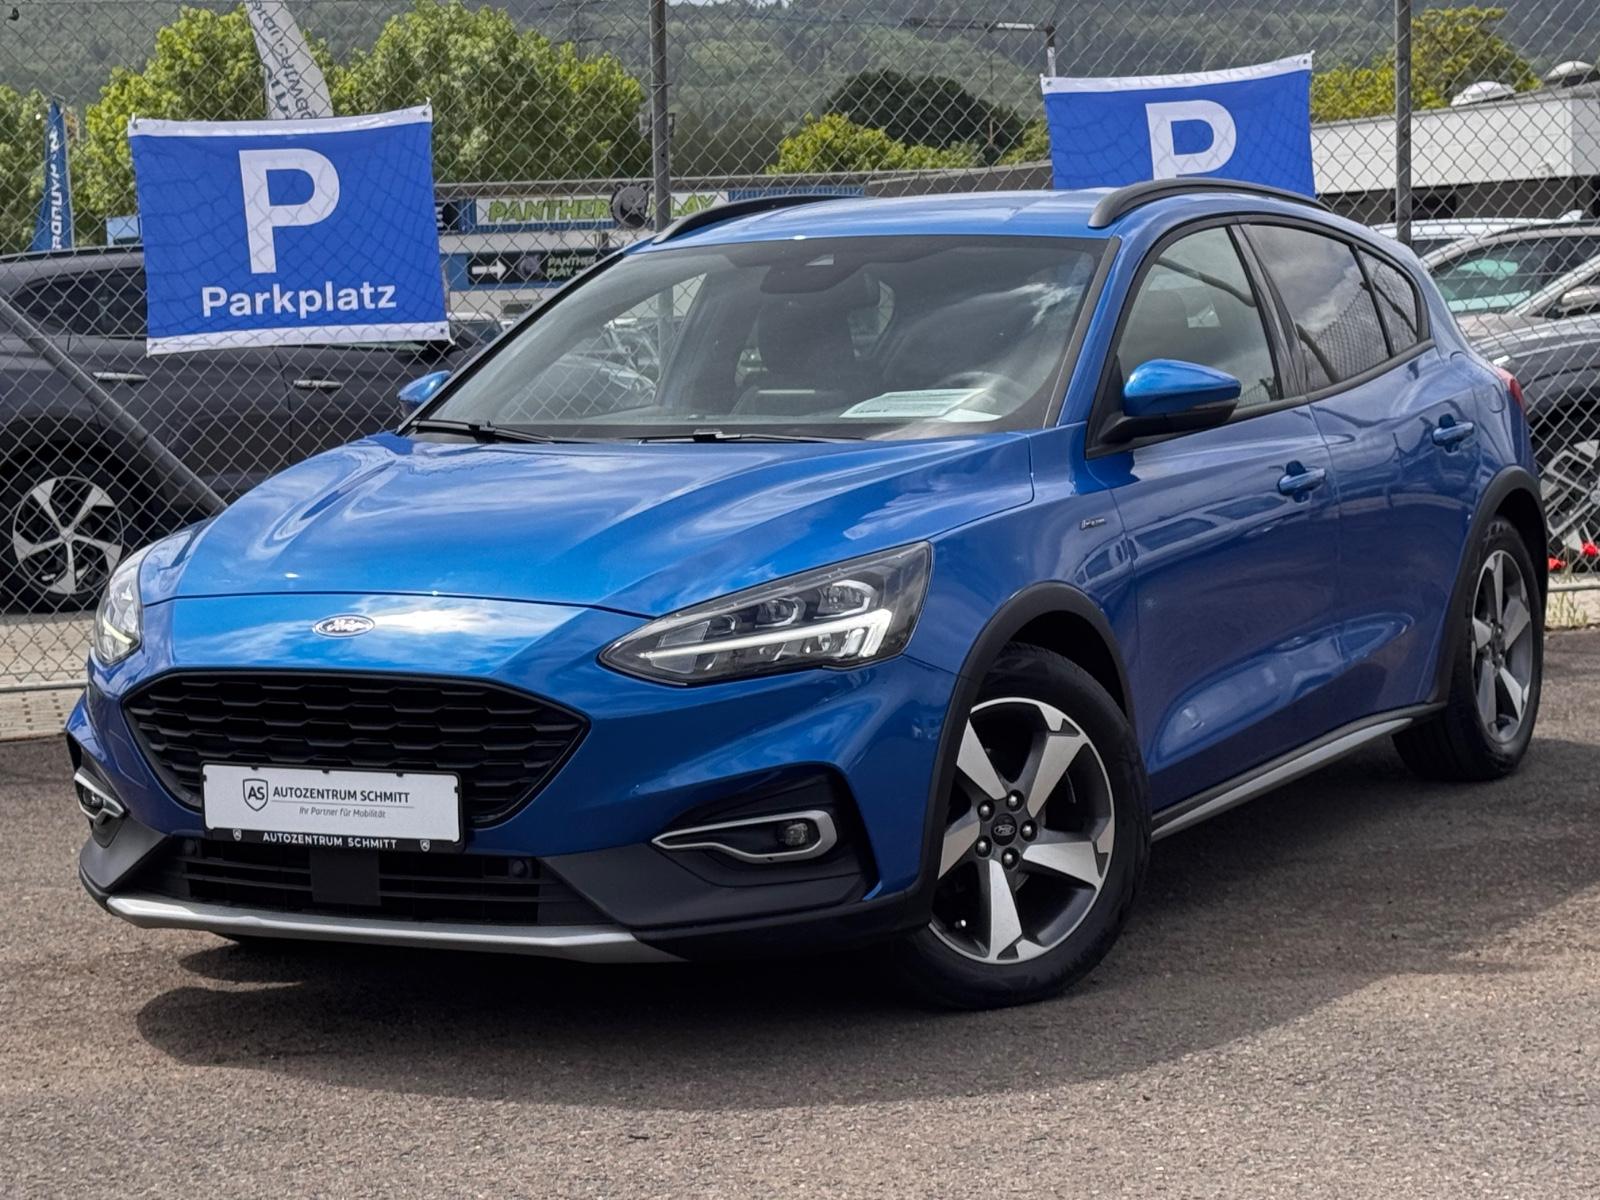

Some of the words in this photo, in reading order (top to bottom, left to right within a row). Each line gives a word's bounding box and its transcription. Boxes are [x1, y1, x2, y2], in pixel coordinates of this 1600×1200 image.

[1145, 99, 1237, 180] P
[239, 148, 340, 274] P
[488, 199, 611, 223] PANTHER
[649, 193, 718, 217] LAY
[202, 281, 397, 319] Parkplatz
[248, 786, 265, 800] AS
[273, 786, 357, 801] AUTOZENTRUM
[360, 790, 410, 803] SCHMITT
[299, 806, 309, 815] Ihr
[311, 807, 338, 816] Partner
[340, 808, 351, 817] für
[353, 809, 386, 818] Mobilität
[263, 832, 343, 846] AUTOZENTRUM
[348, 837, 397, 848] SCHMITT
